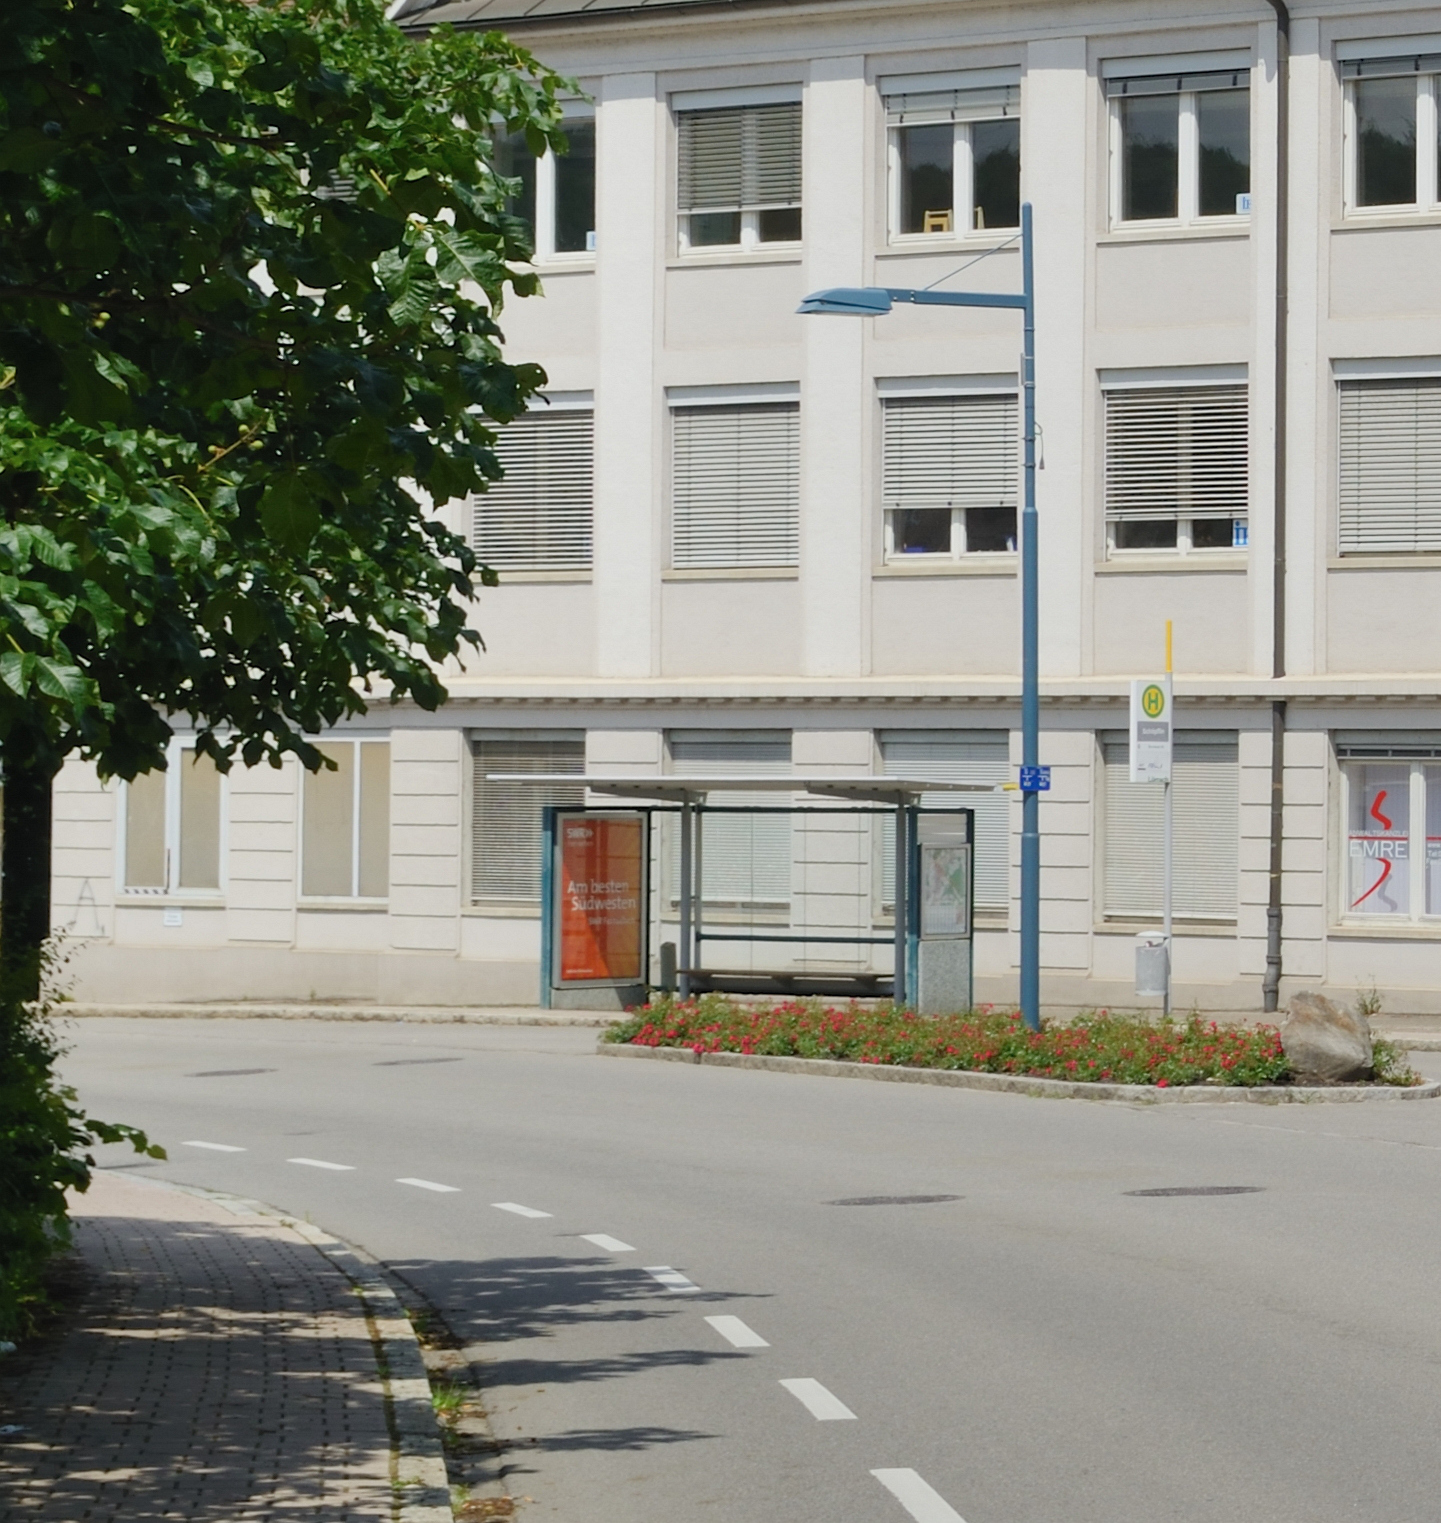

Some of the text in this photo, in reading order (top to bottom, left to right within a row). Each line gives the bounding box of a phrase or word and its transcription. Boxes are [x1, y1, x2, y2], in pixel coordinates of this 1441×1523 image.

[1148, 692, 1158, 710] H
[1350, 840, 1408, 858] EMRE
[567, 878, 629, 894] Am besten
[571, 895, 636, 911] Südwesten
